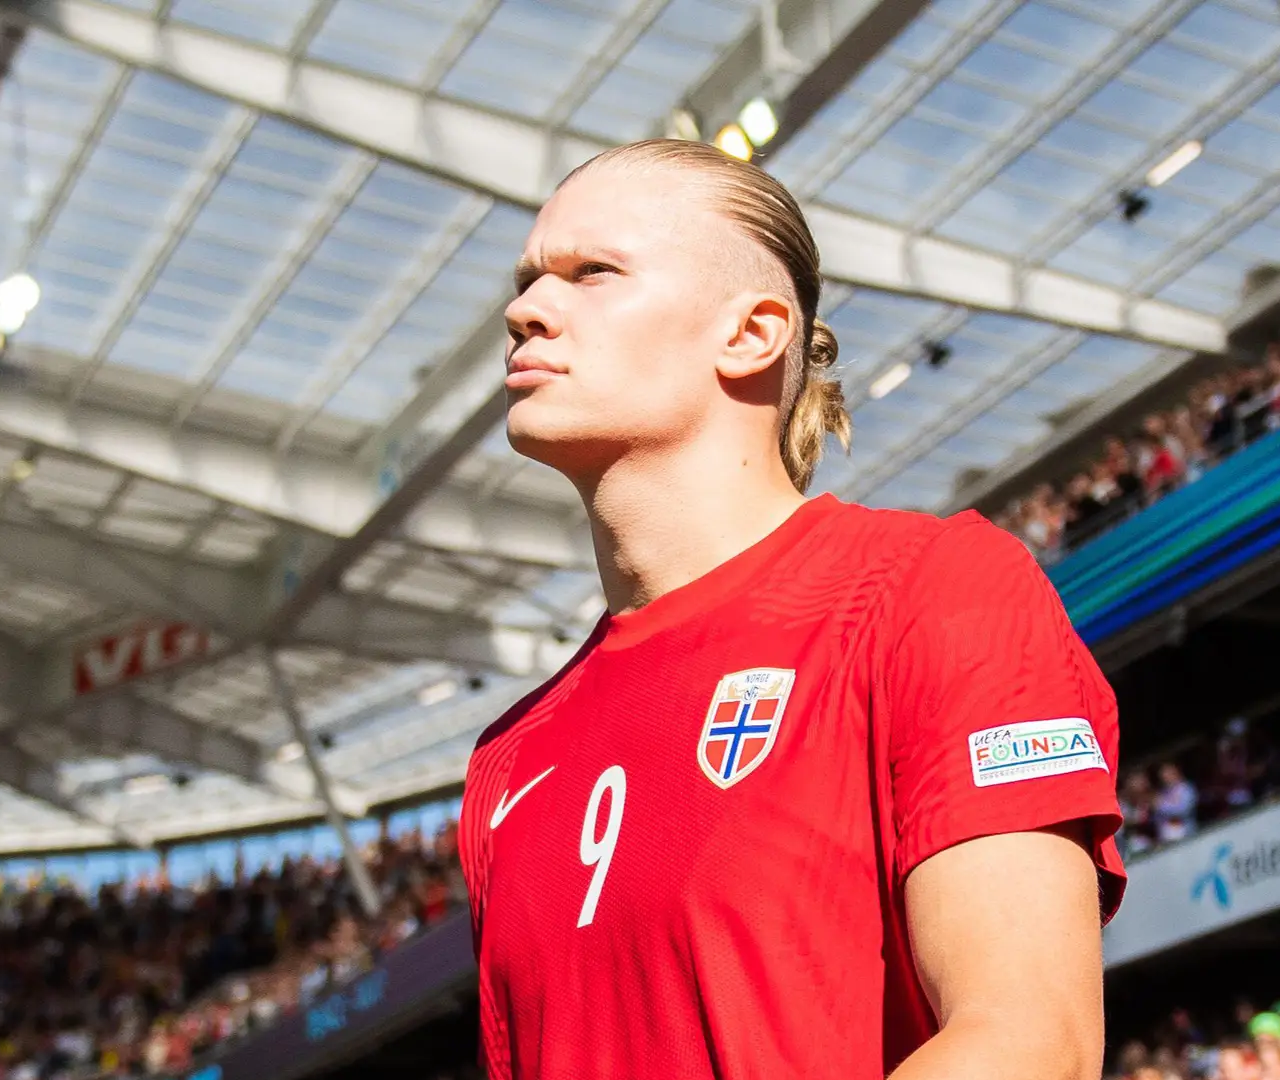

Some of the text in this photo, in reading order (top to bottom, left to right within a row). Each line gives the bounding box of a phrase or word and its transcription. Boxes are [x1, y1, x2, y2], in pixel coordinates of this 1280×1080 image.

[745, 673, 771, 684] NORGE
[974, 729, 1012, 746] UEFA
[578, 765, 626, 928] 9
